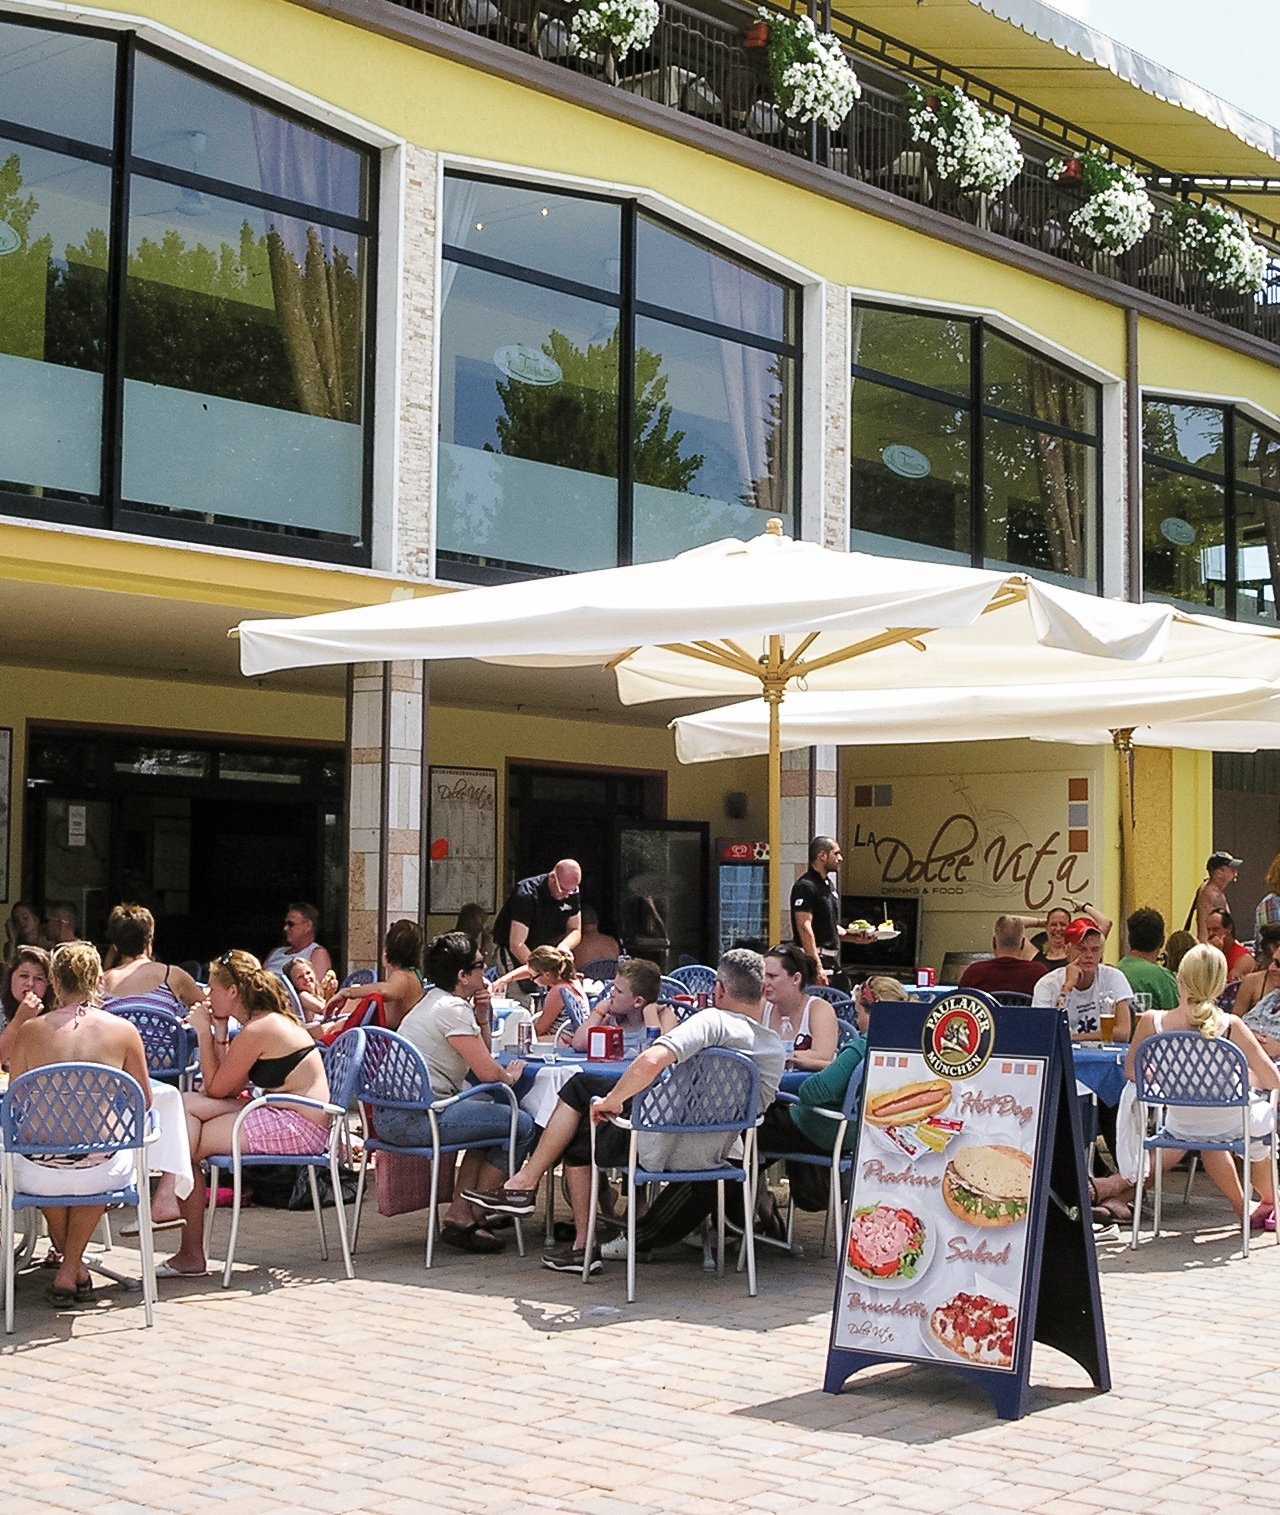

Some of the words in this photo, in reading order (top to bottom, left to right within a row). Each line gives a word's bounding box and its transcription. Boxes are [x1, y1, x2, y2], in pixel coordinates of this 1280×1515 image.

[853, 824, 876, 848] LA
[873, 813, 979, 884] Dolce
[983, 831, 1090, 910] Vita
[880, 886, 920, 895] DRINKS
[932, 886, 965, 895] FOOD
[926, 997, 991, 1034] PAULANER
[945, 1235, 1013, 1265] Salad
